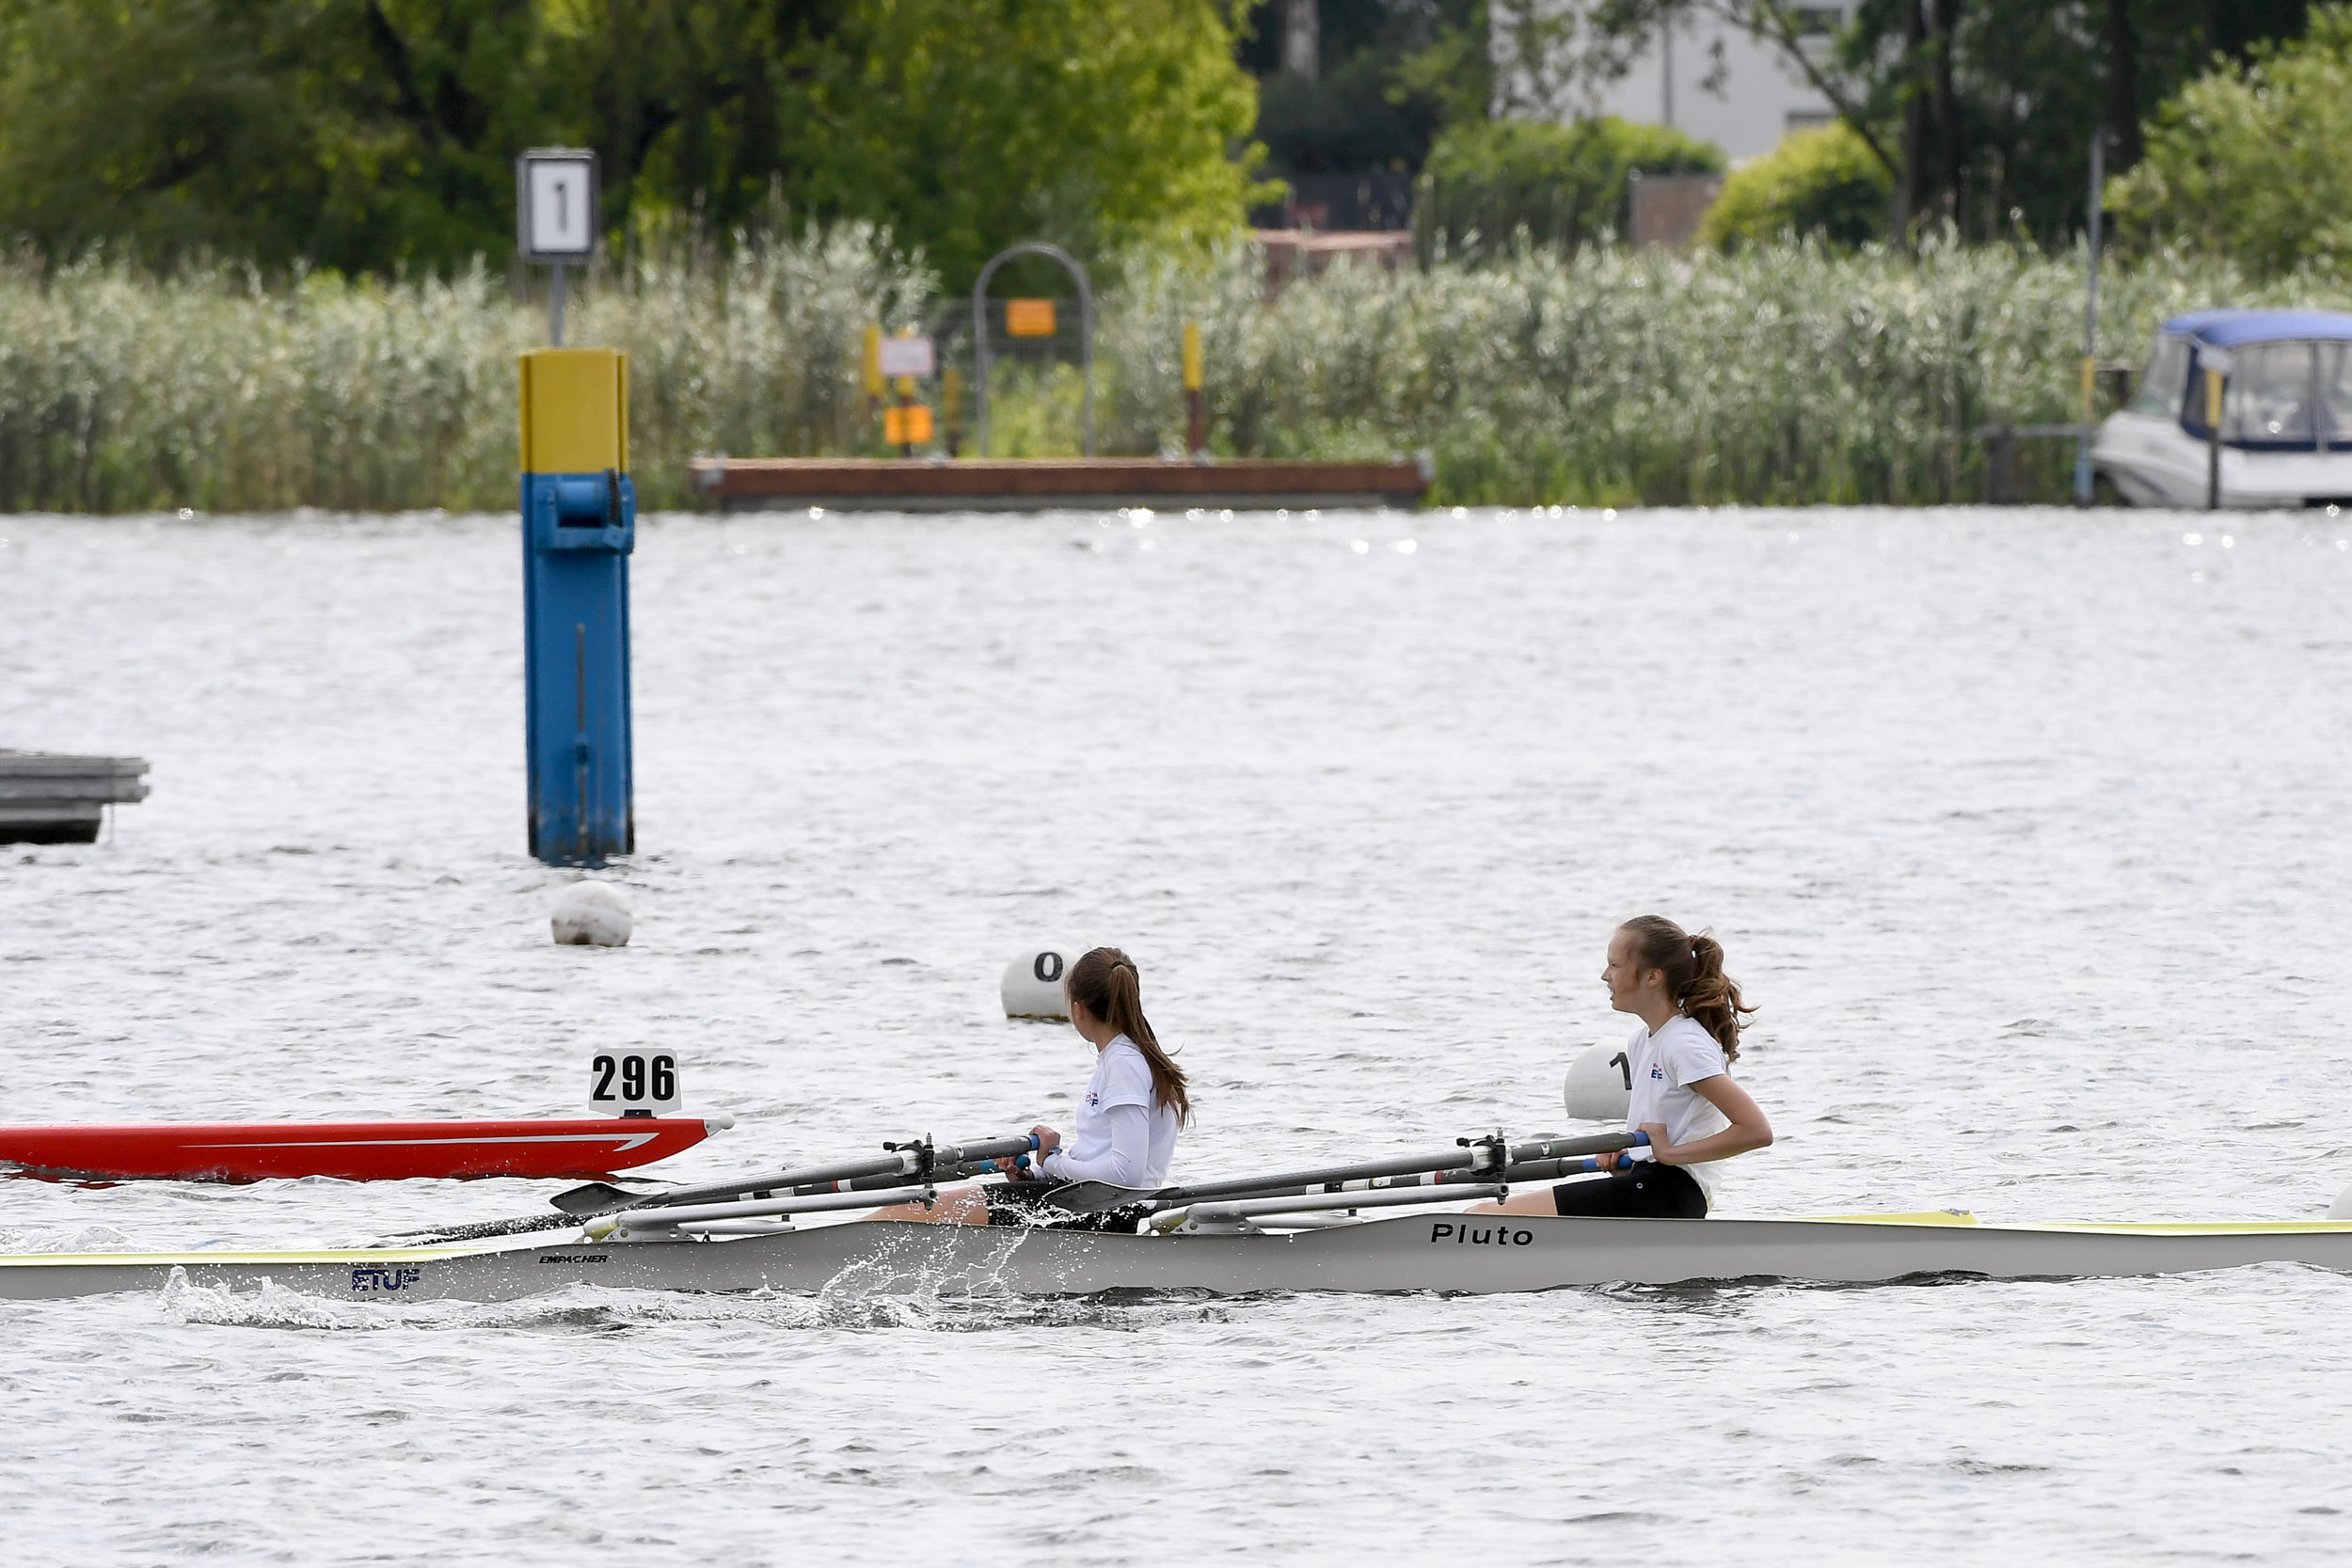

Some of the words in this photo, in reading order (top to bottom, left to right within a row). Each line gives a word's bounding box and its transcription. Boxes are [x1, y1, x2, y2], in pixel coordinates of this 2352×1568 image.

[552, 181, 568, 232] 1
[592, 1054, 675, 1101] 296
[1430, 1223, 1534, 1246] Pluto
[538, 1255, 609, 1264] EMPACHER
[352, 1268, 421, 1291] ETUF
